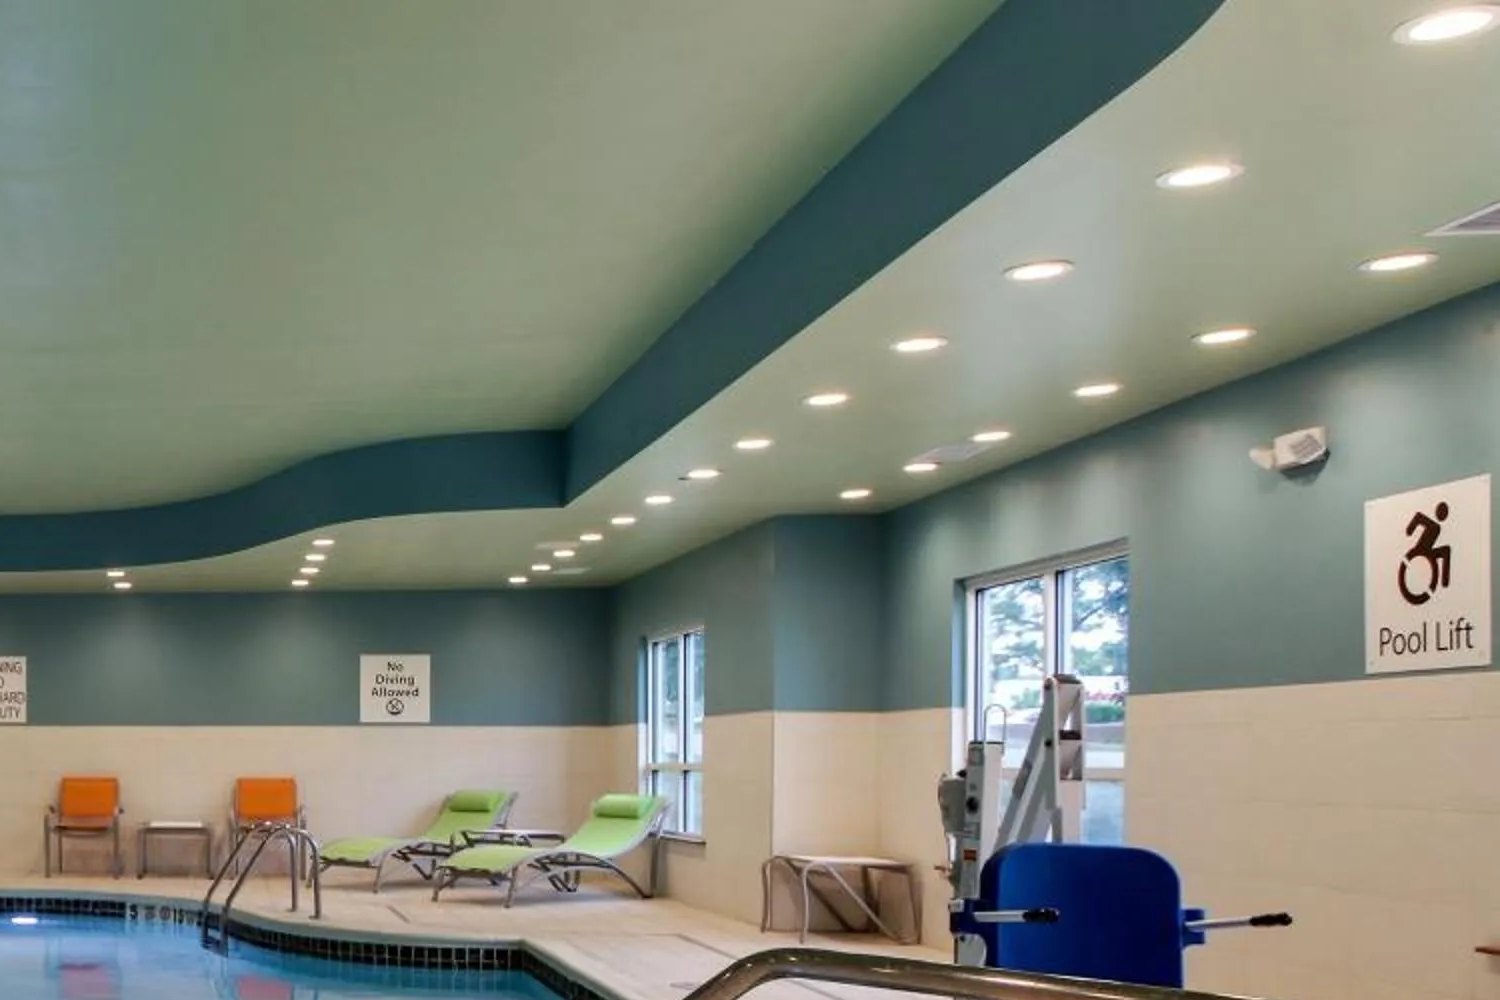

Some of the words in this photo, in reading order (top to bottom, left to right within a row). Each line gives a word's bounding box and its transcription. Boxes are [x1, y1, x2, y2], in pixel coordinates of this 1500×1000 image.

[1379, 620, 1428, 656] Pool
[1435, 616, 1475, 651] Lift
[387, 661, 404, 671] No
[375, 674, 415, 685] Diving
[371, 687, 419, 697] Allowed
